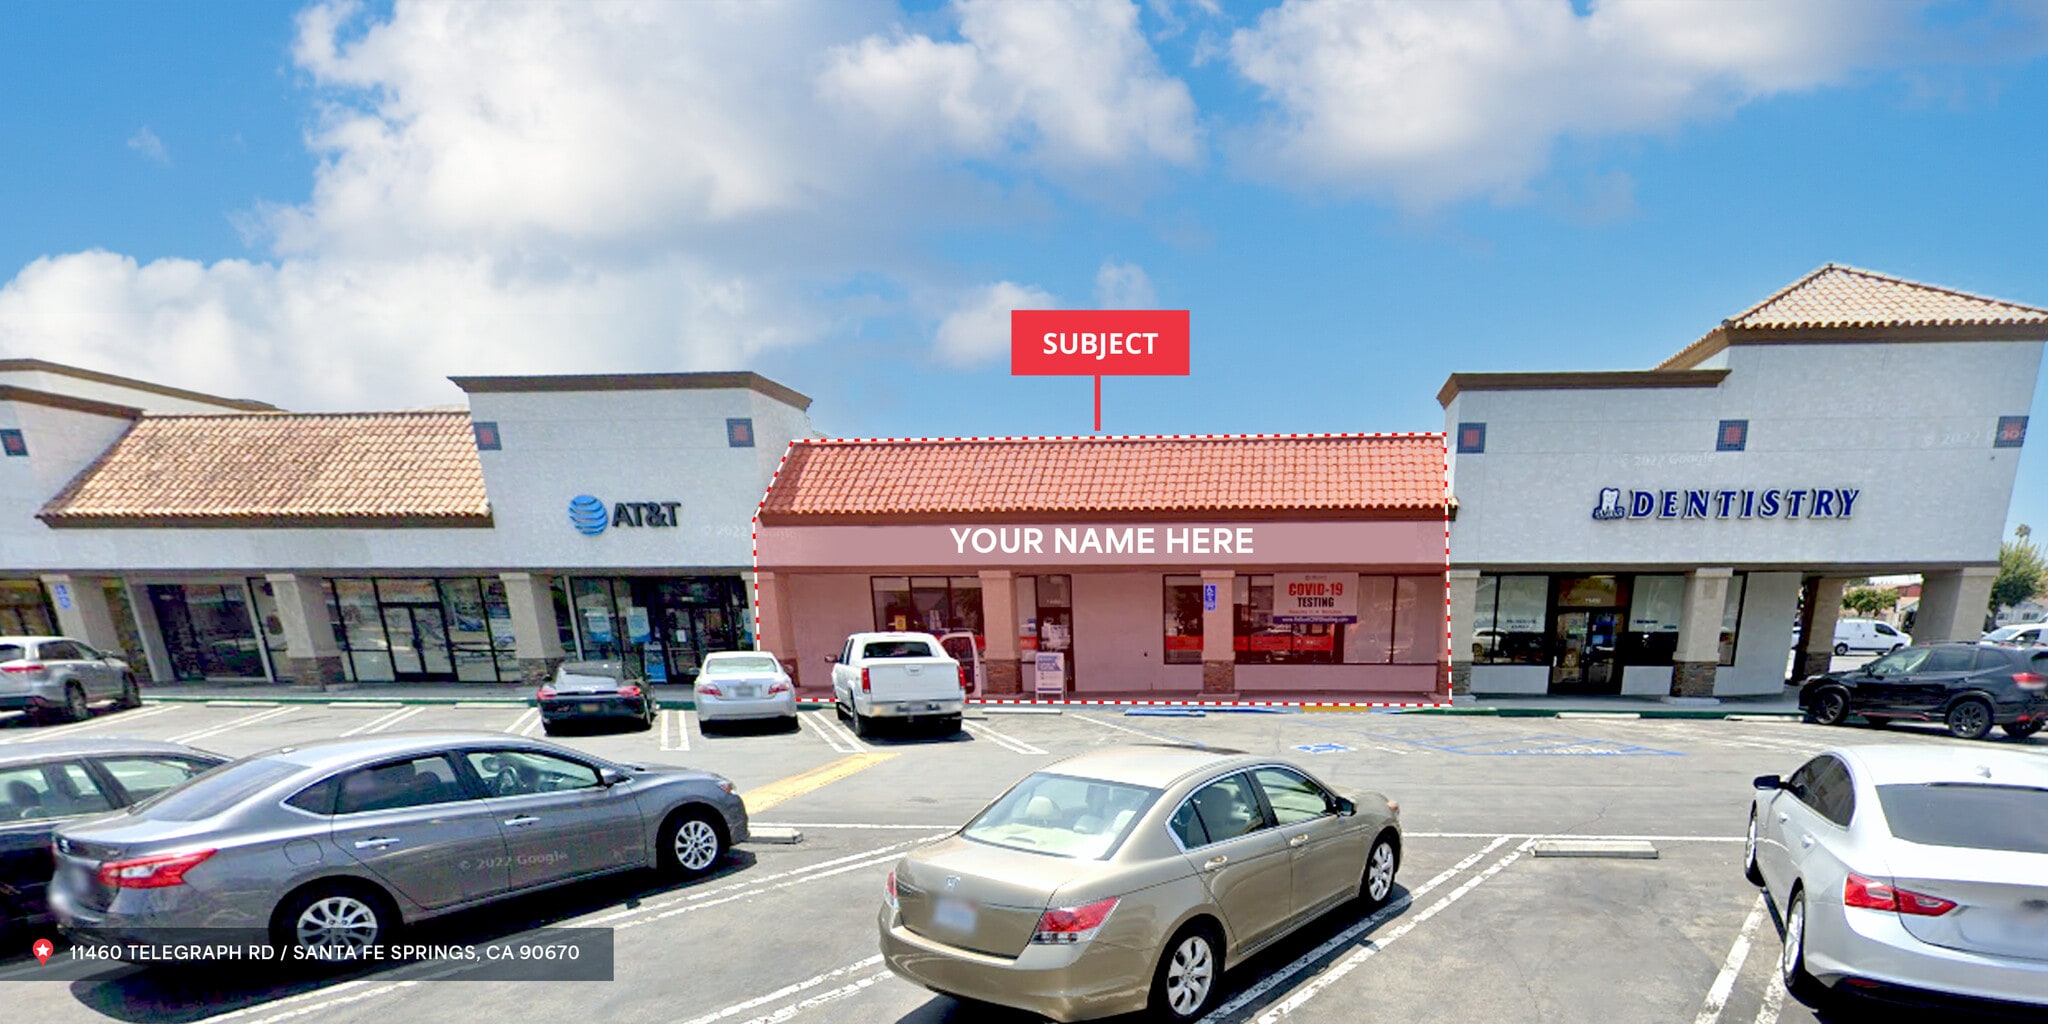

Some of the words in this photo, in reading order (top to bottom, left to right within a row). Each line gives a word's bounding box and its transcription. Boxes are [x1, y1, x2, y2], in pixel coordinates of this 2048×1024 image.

[1628, 489, 1861, 520] DENTISTRY
[612, 502, 681, 527] AT&T
[1288, 582, 1344, 596] COVID-19
[1297, 597, 1335, 608] TESTING
